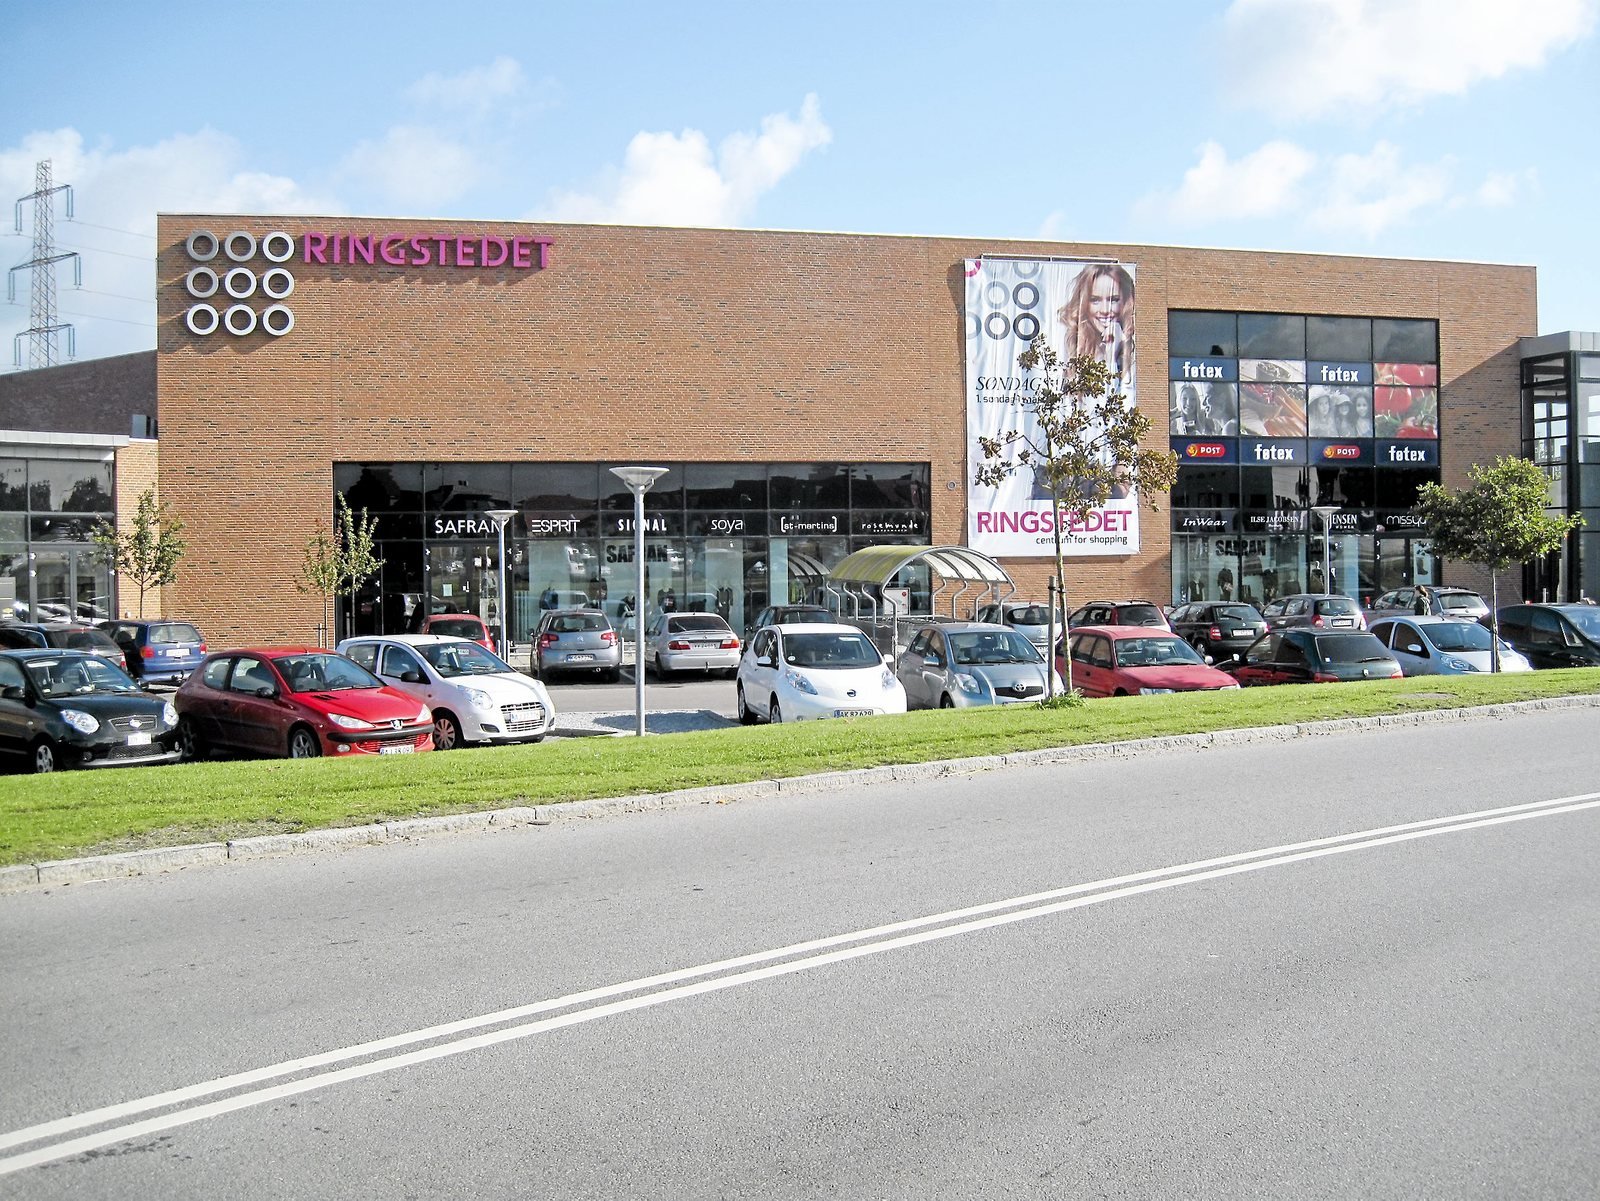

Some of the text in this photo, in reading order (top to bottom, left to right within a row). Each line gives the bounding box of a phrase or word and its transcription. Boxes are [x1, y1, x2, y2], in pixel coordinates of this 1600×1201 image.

[304, 232, 554, 268] RINGSTEDET
[1201, 446, 1221, 455] POST
[1337, 448, 1356, 456] POST
[434, 519, 500, 534] SAFRAN
[531, 519, 580, 533] ESPRIT
[711, 518, 743, 534] soya
[977, 510, 1132, 533] RINGSTEDET
[1183, 517, 1228, 527] InWear
[1075, 535, 1087, 543] for
[1090, 535, 1128, 545] shopping
[606, 545, 667, 563] SAFAN
